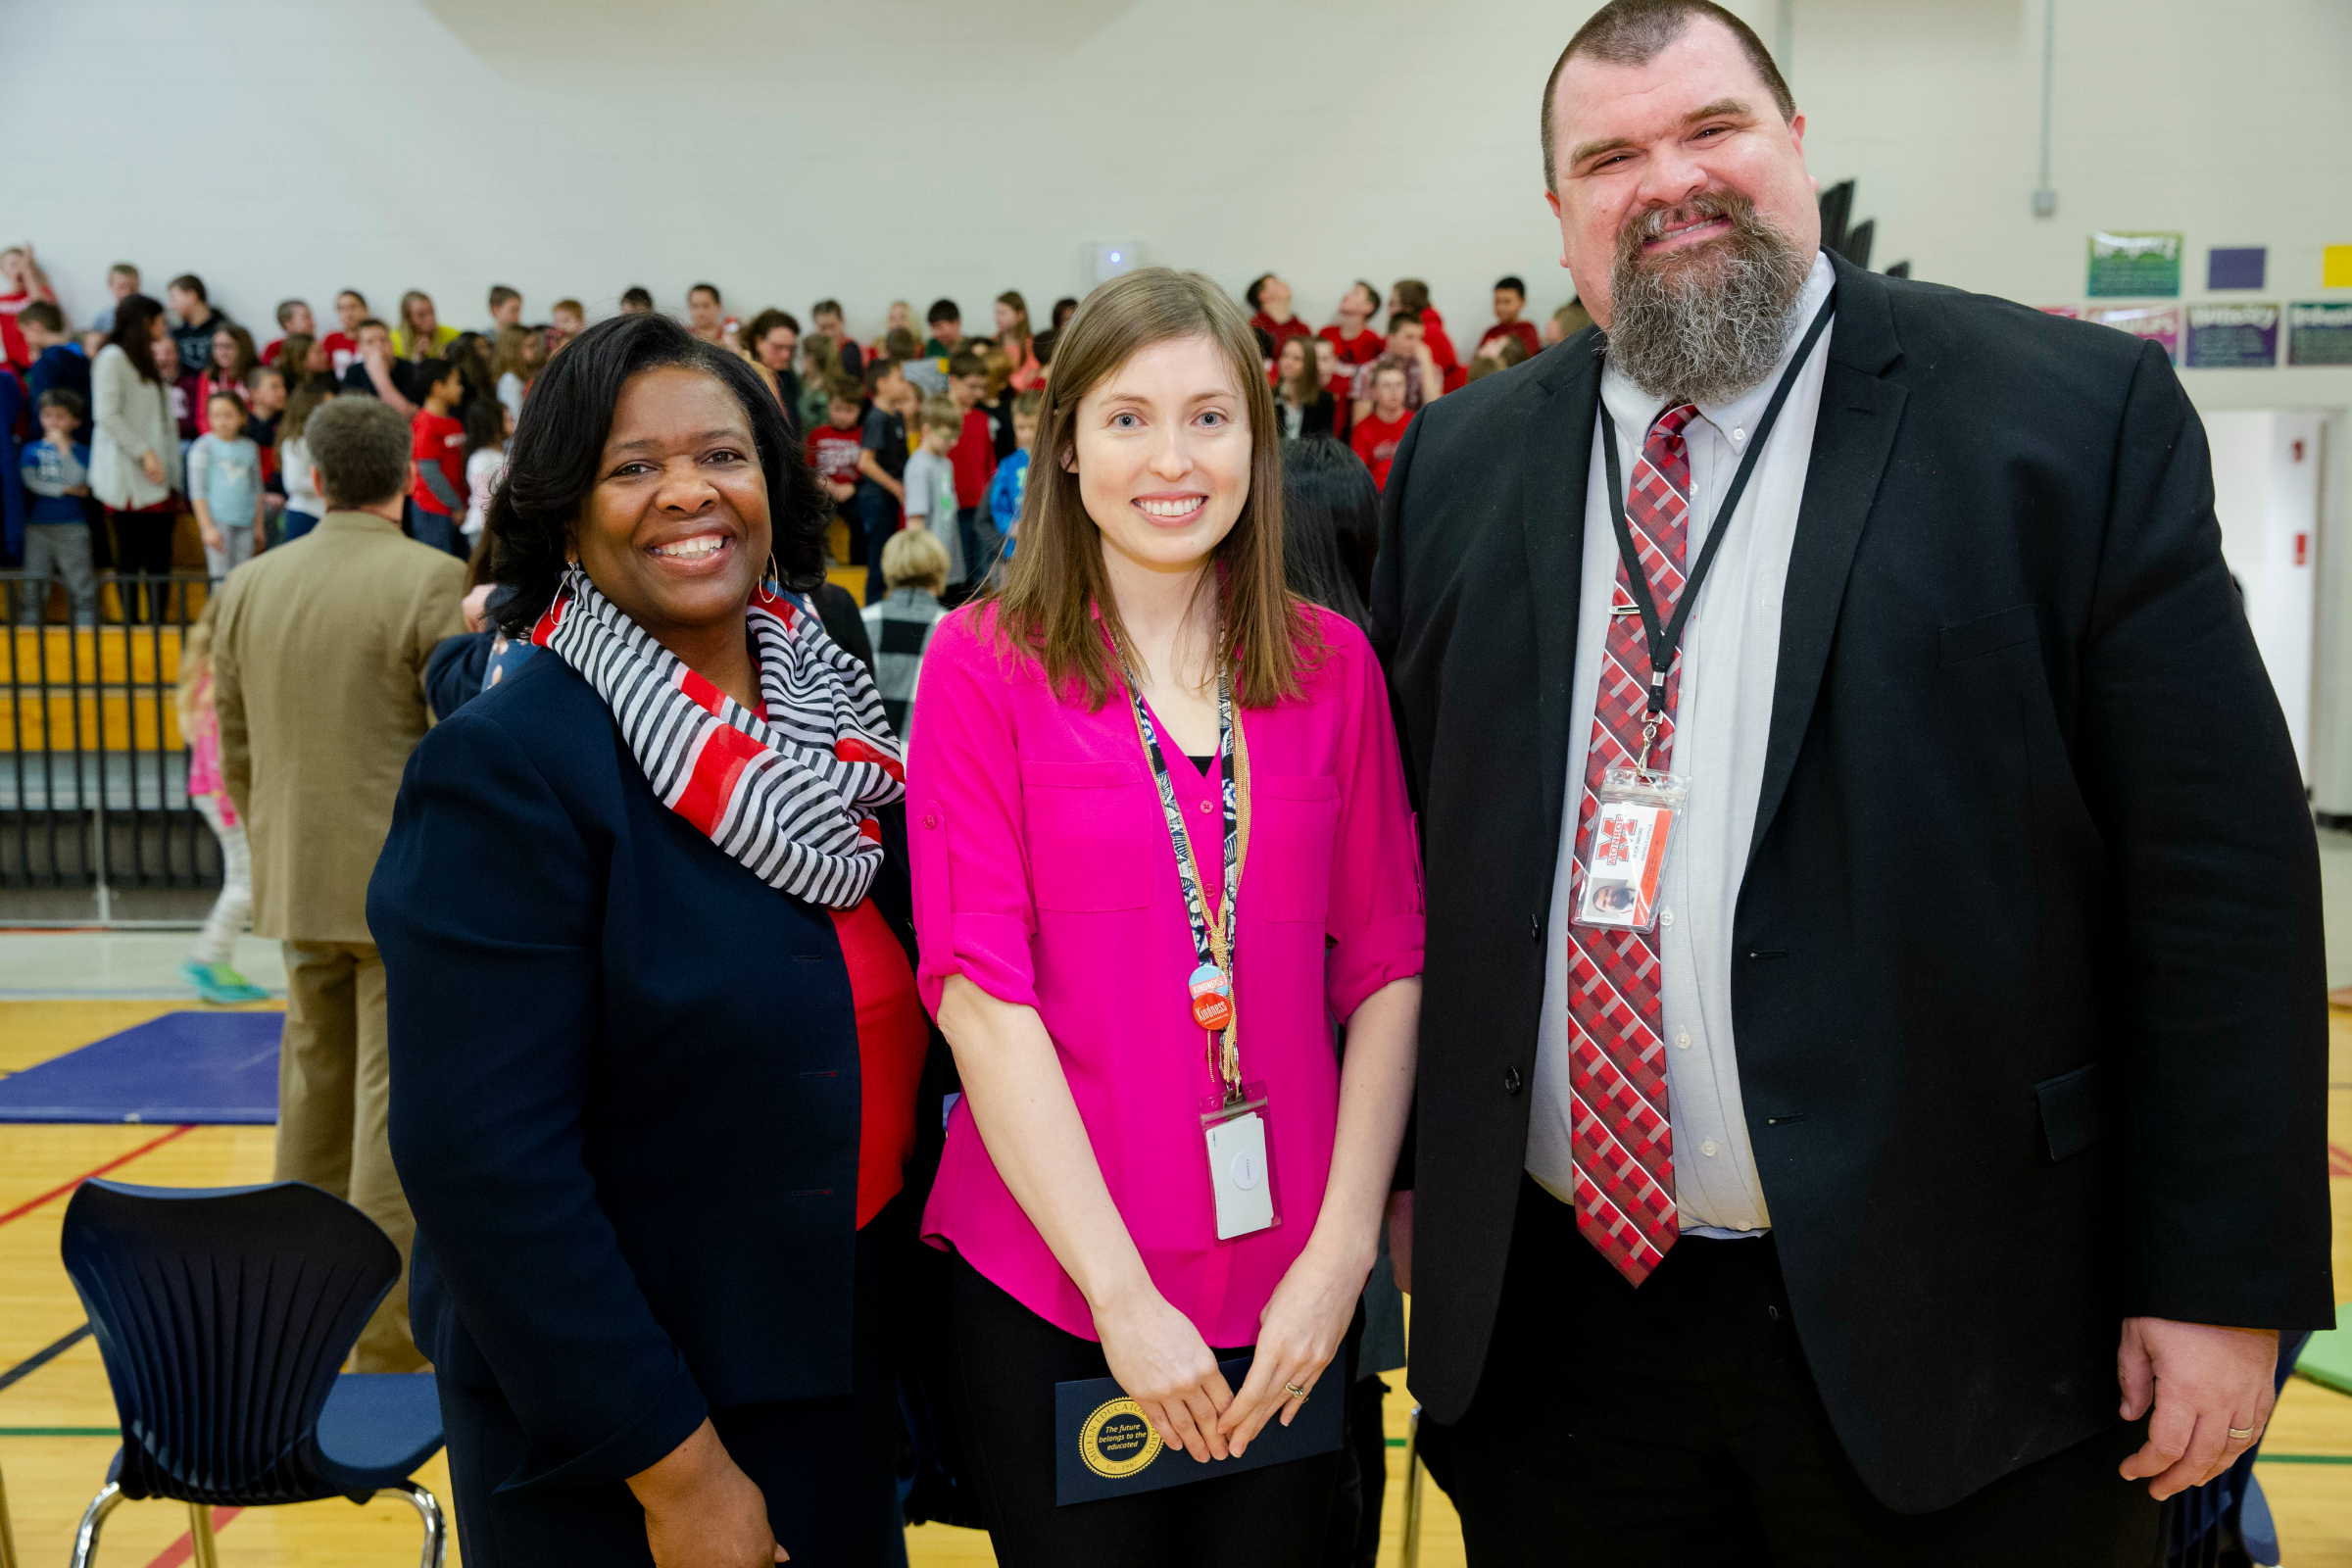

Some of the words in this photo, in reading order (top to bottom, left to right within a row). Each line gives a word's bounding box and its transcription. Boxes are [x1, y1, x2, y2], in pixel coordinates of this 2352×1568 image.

[1609, 815, 1624, 864] MONROE
[1195, 1001, 1227, 1021] Kindness
[1119, 1424, 1141, 1433] future
[1086, 1425, 1100, 1462] MILKEN
[1099, 1434, 1124, 1444] belongs
[1106, 1440, 1139, 1450] educated
[1122, 1461, 1137, 1471] 1987
